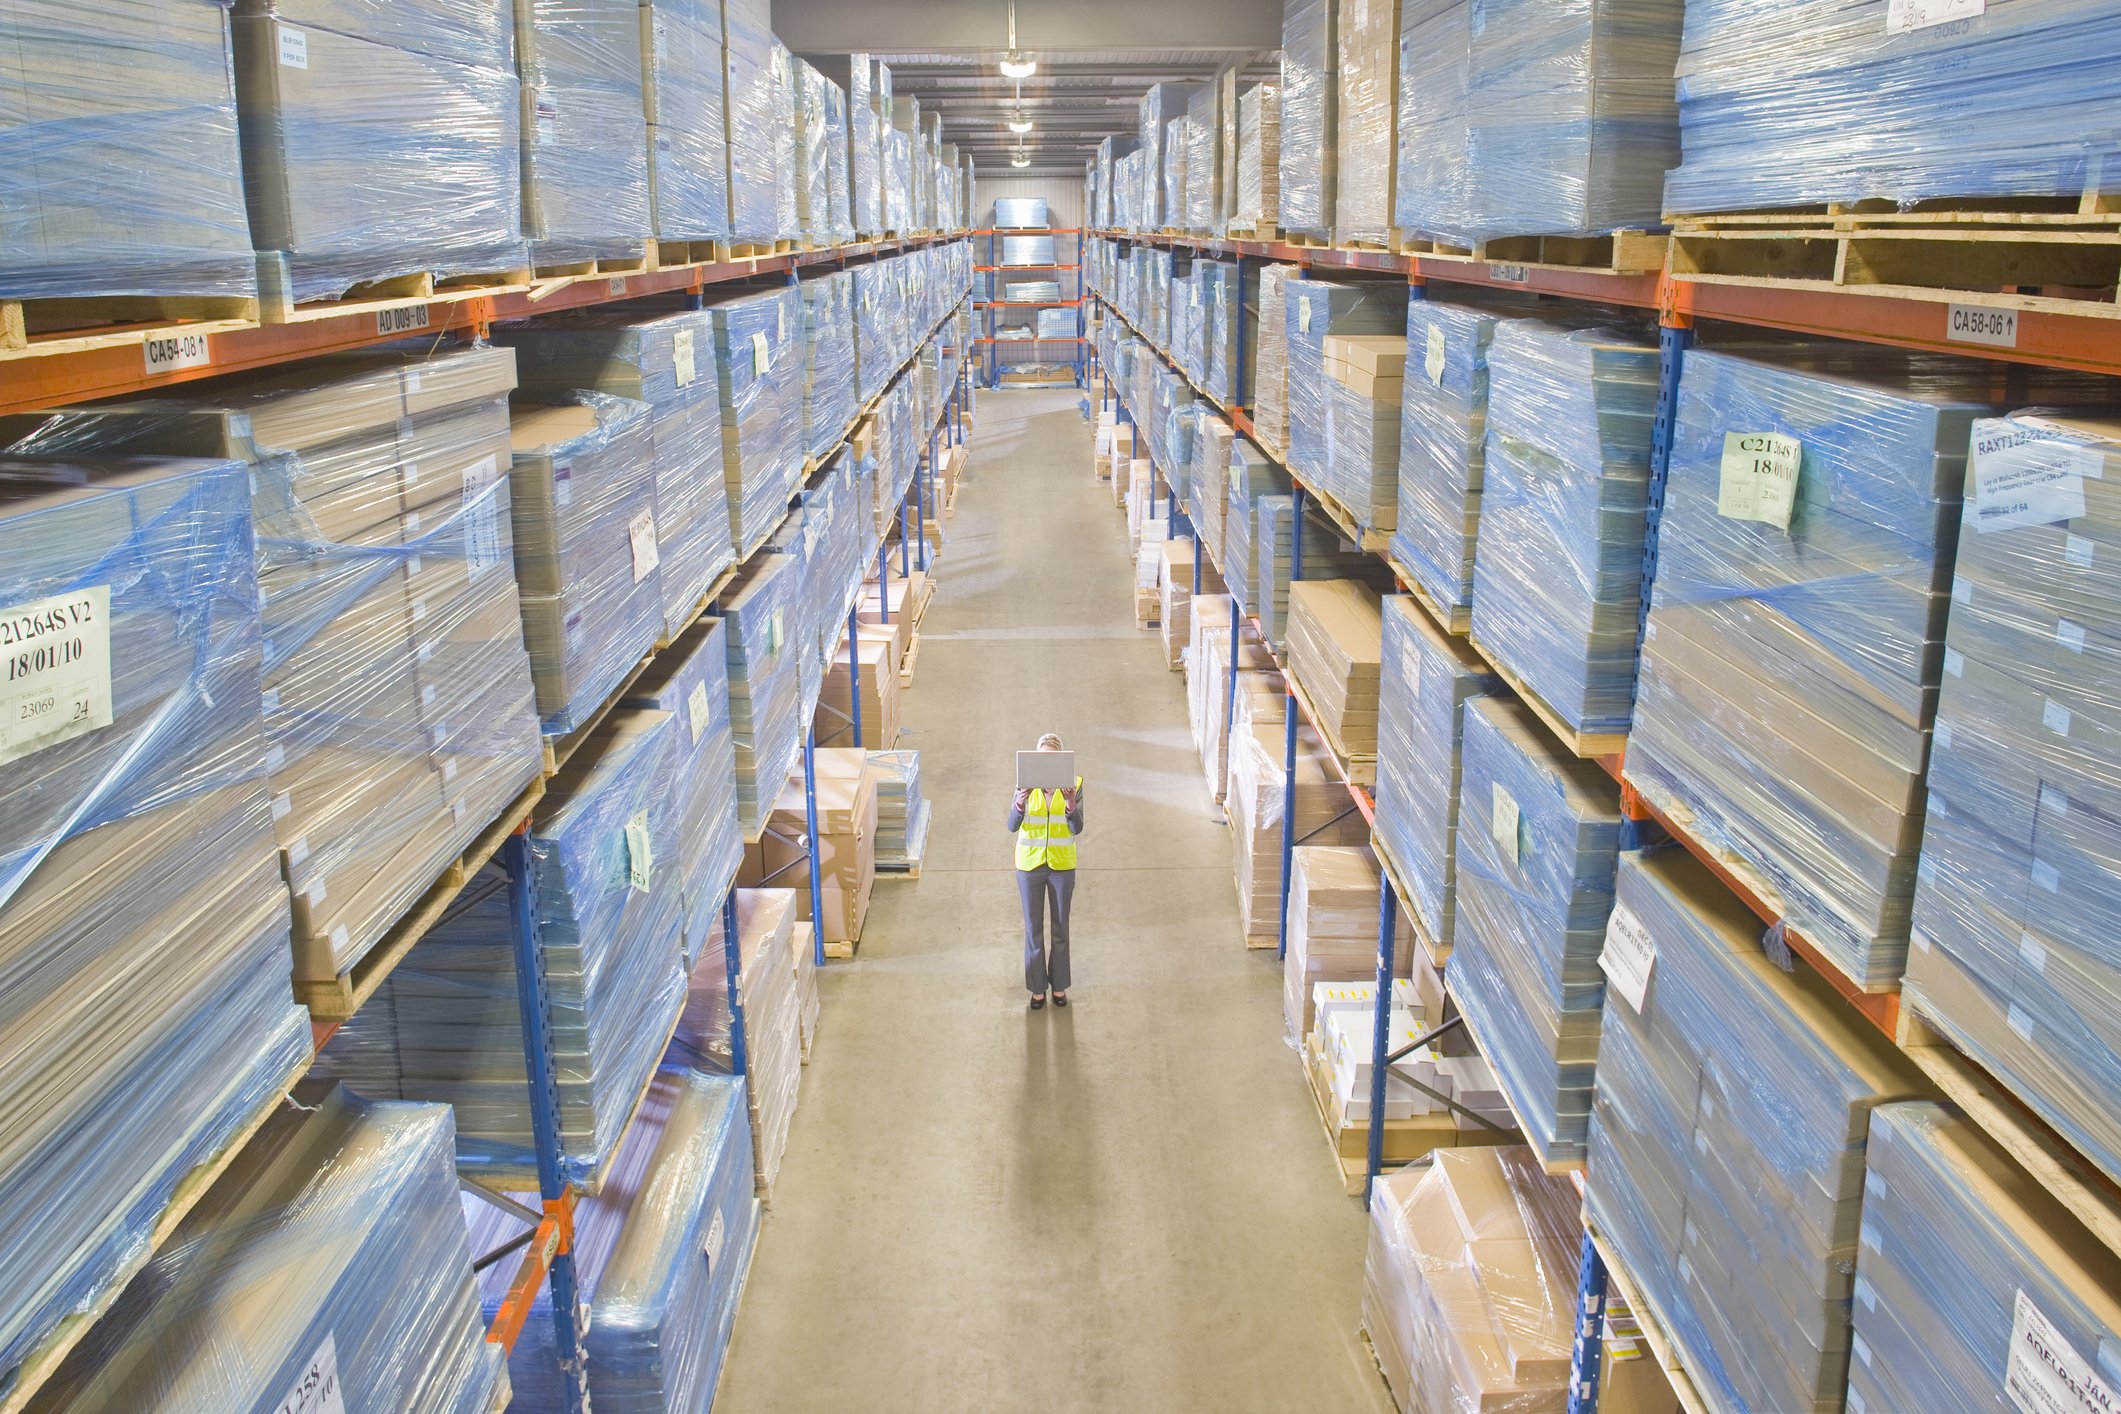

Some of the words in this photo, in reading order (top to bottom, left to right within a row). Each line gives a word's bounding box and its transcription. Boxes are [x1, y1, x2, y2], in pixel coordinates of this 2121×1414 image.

[379, 310, 392, 333] AD
[0, 608, 67, 646] 21264S
[69, 600, 92, 624] V2
[8, 637, 83, 682] 18/01/10
[21, 696, 55, 720] 23069
[73, 699, 89, 720] 24
